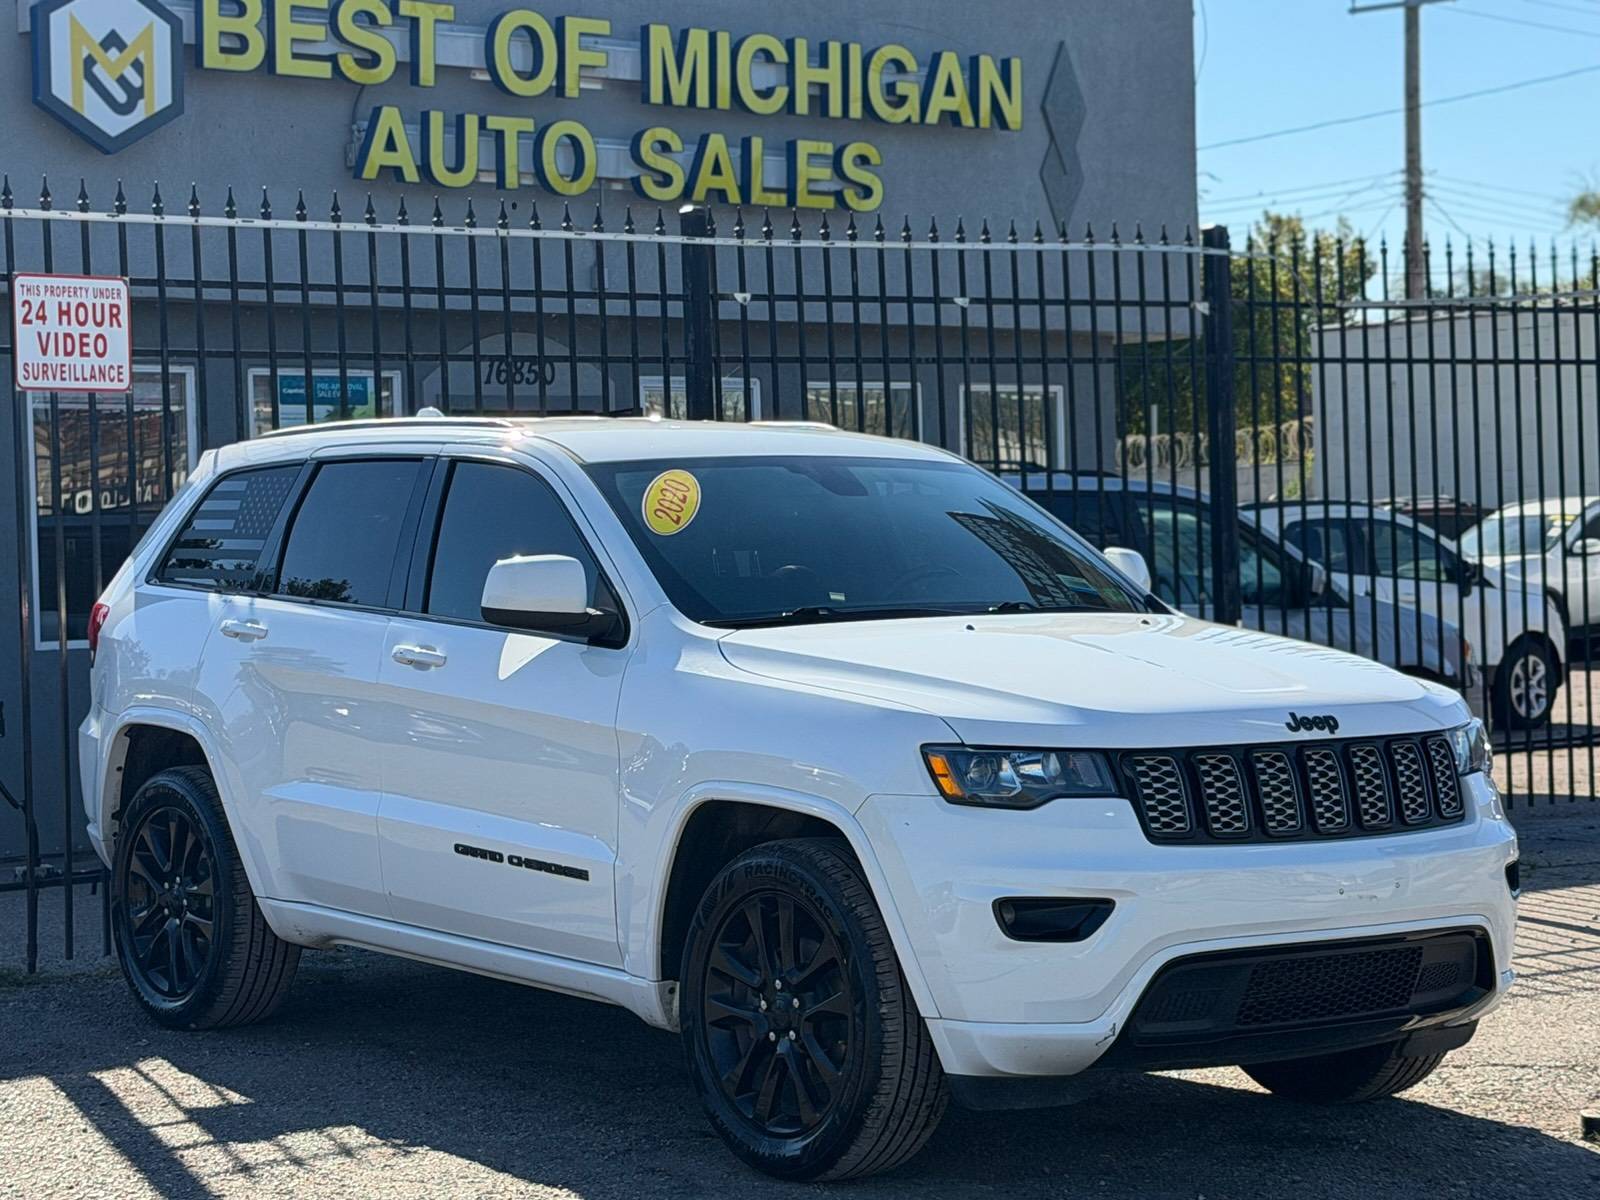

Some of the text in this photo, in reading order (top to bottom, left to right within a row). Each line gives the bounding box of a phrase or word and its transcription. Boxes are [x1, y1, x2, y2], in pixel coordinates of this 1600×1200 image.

[198, 0, 1023, 131] BEST OF MICHIGAN
[355, 105, 884, 212] AUTO SALES
[20, 283, 122, 300] THIS PROPERTY UNDER
[21, 299, 122, 329] 24 HOUR
[37, 330, 108, 359] VIDEO
[22, 362, 125, 384] SURVEILLANCE
[653, 478, 690, 526] 2020
[1285, 711, 1339, 735] Jeep
